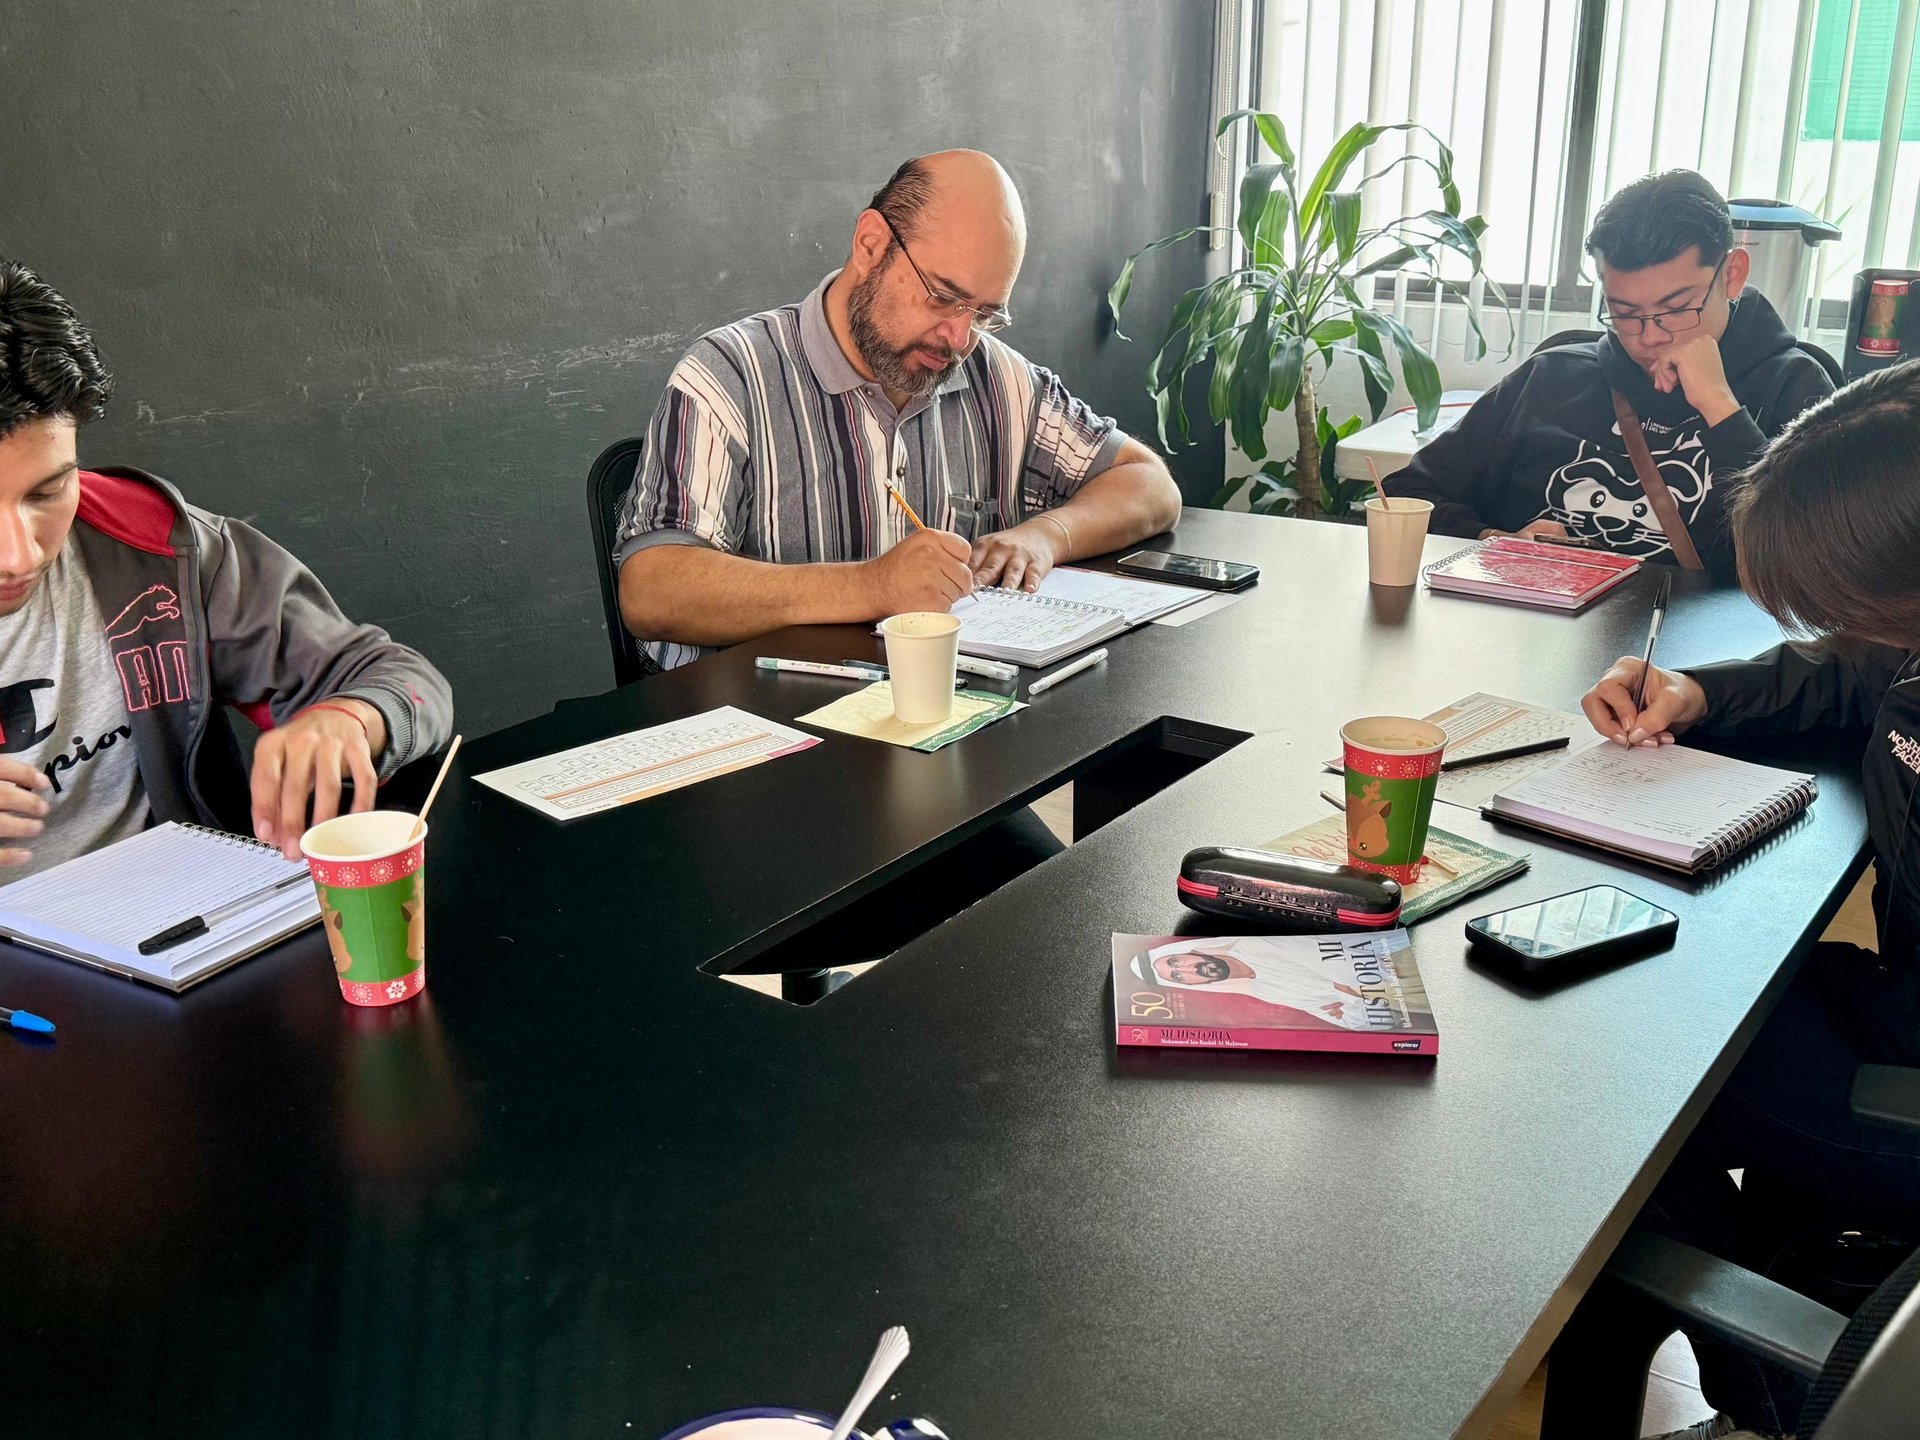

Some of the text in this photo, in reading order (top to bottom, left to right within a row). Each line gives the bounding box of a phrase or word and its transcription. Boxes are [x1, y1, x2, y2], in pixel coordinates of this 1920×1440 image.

[1891, 746, 1919, 771] FACE
[1318, 940, 1346, 962] MI
[1348, 940, 1396, 1027] HISTORIA
[1130, 992, 1174, 1019] 50
[1160, 1029, 1173, 1038] MI
[1177, 1029, 1232, 1040] HISTORIA
